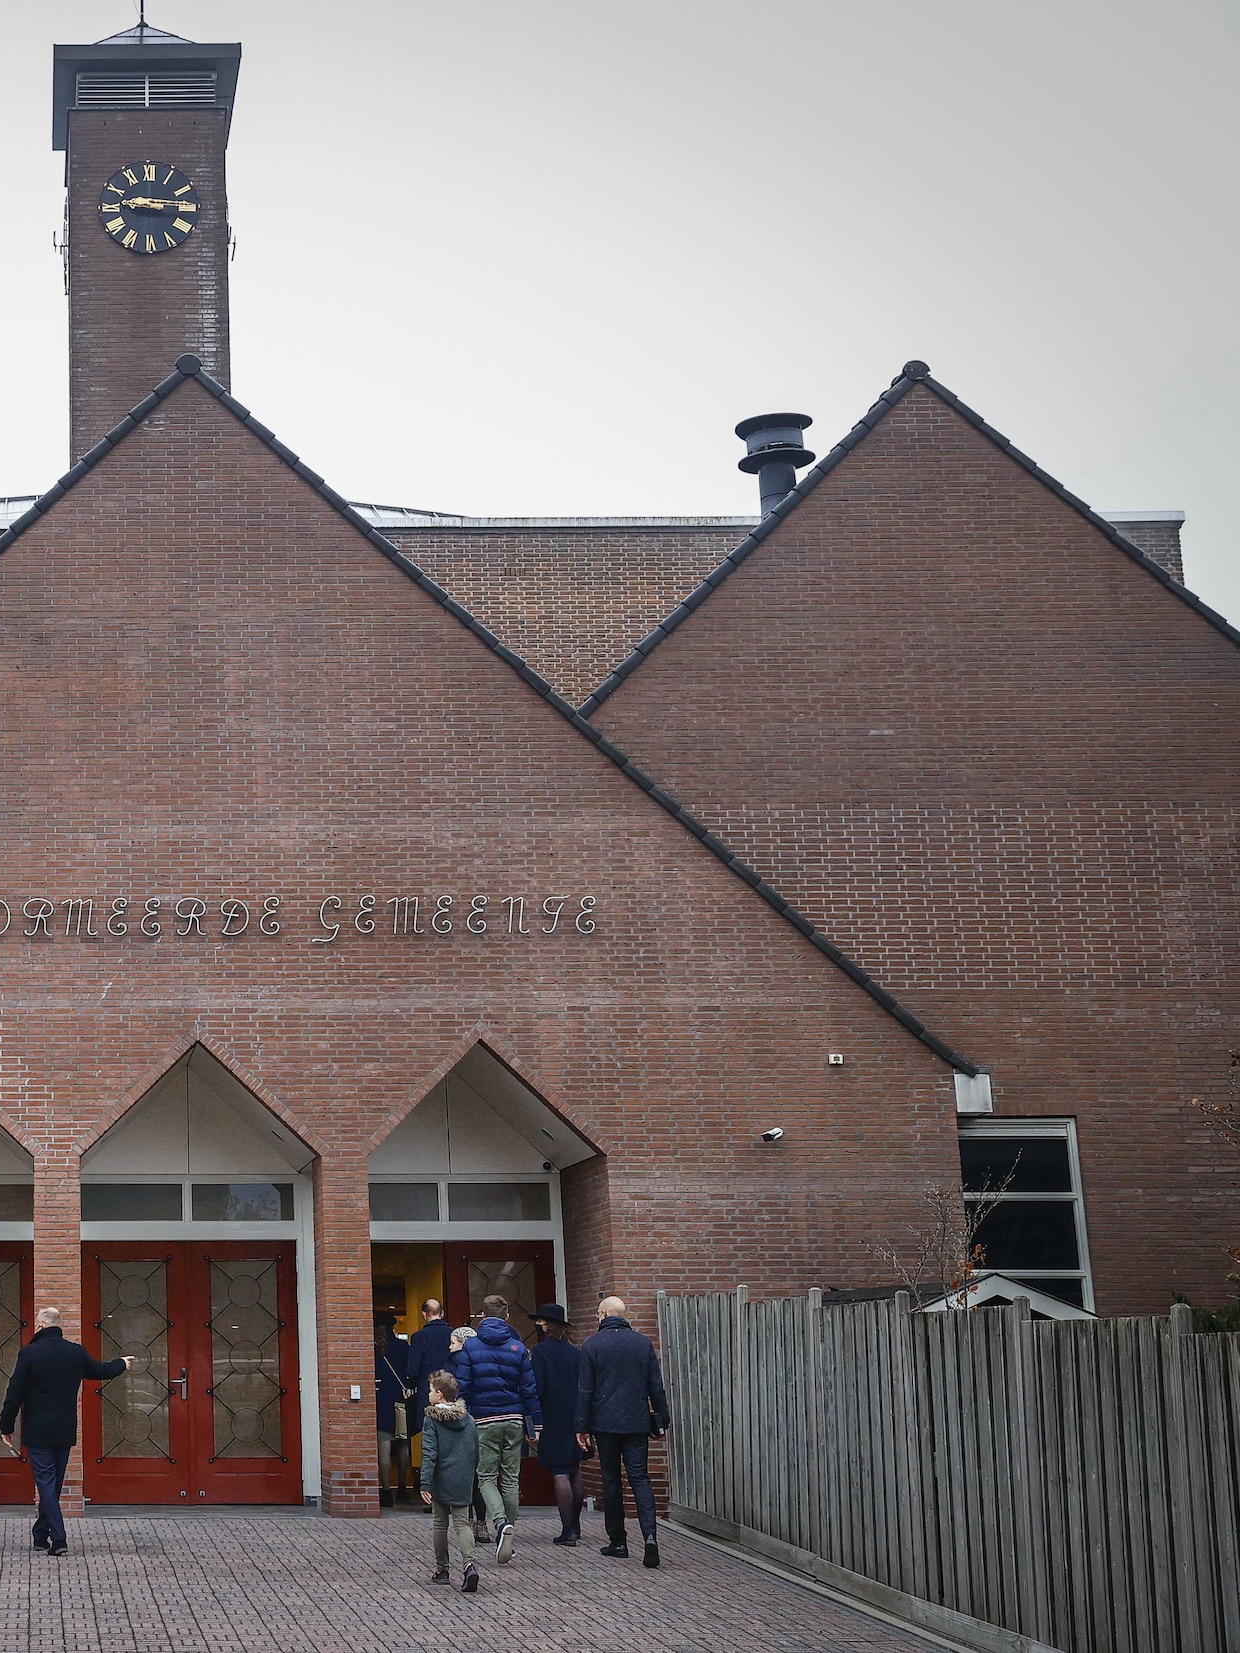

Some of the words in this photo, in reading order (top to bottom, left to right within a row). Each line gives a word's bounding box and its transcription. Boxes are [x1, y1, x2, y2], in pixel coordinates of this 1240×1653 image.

[123, 169, 139, 187] XI
[143, 165, 156, 182] XII
[163, 170, 174, 185] I
[107, 183, 126, 197] X
[173, 184, 192, 197] II
[102, 203, 121, 212] IX
[106, 216, 126, 235] VIII
[122, 229, 139, 248] VII
[145, 234, 157, 251] VI
[163, 231, 178, 247] V
[311, 894, 597, 943] GEMEENTE
